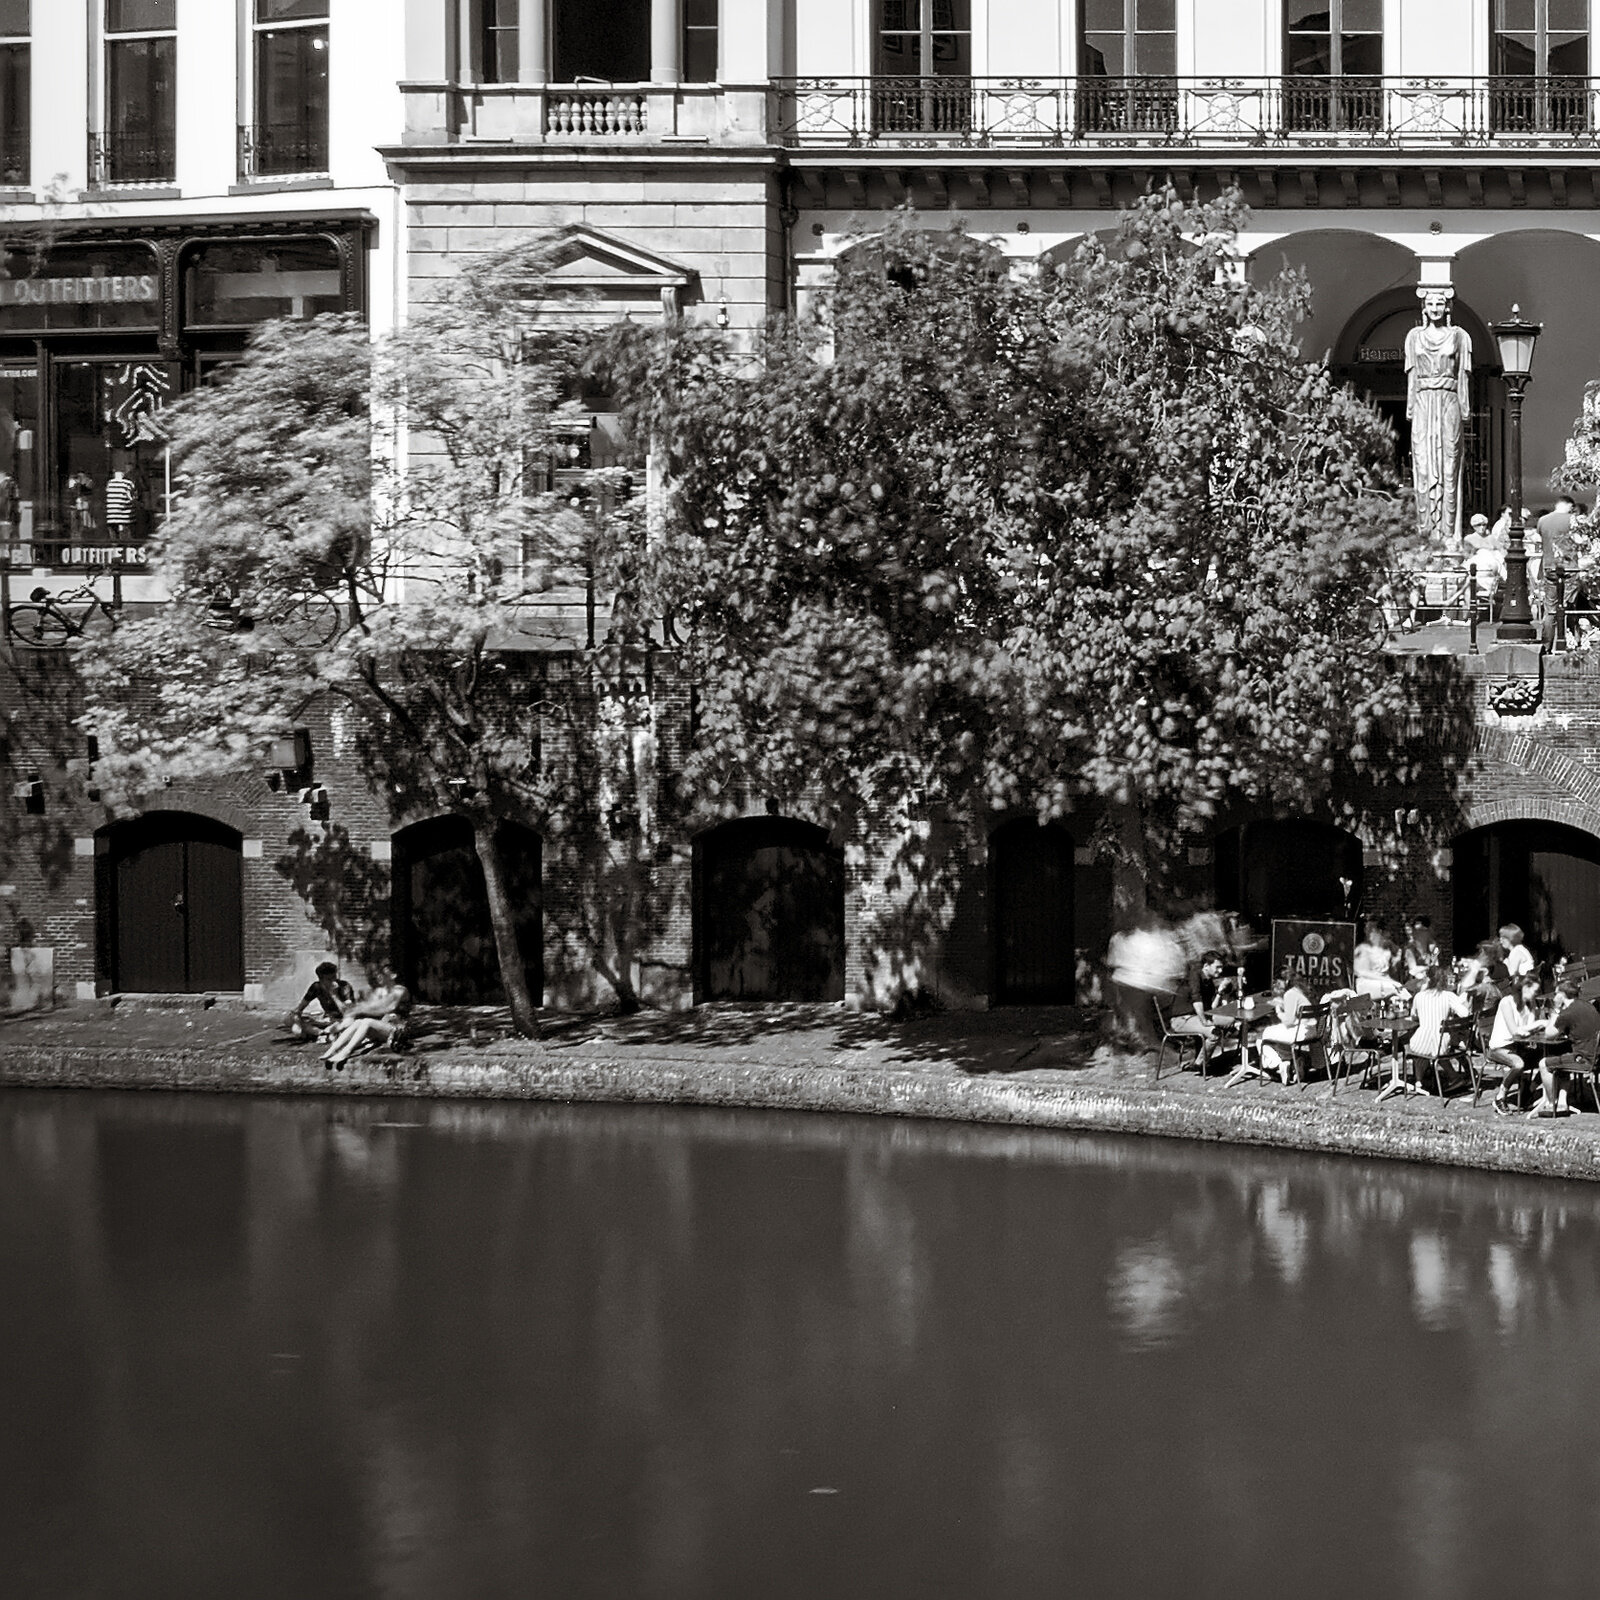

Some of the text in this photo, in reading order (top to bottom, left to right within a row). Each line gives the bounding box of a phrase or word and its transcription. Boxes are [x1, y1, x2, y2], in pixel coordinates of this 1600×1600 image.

[15, 276, 153, 304] OUTFITTERS
[1361, 348, 1406, 360] Heinek
[1285, 955, 1342, 976] TAPAS
